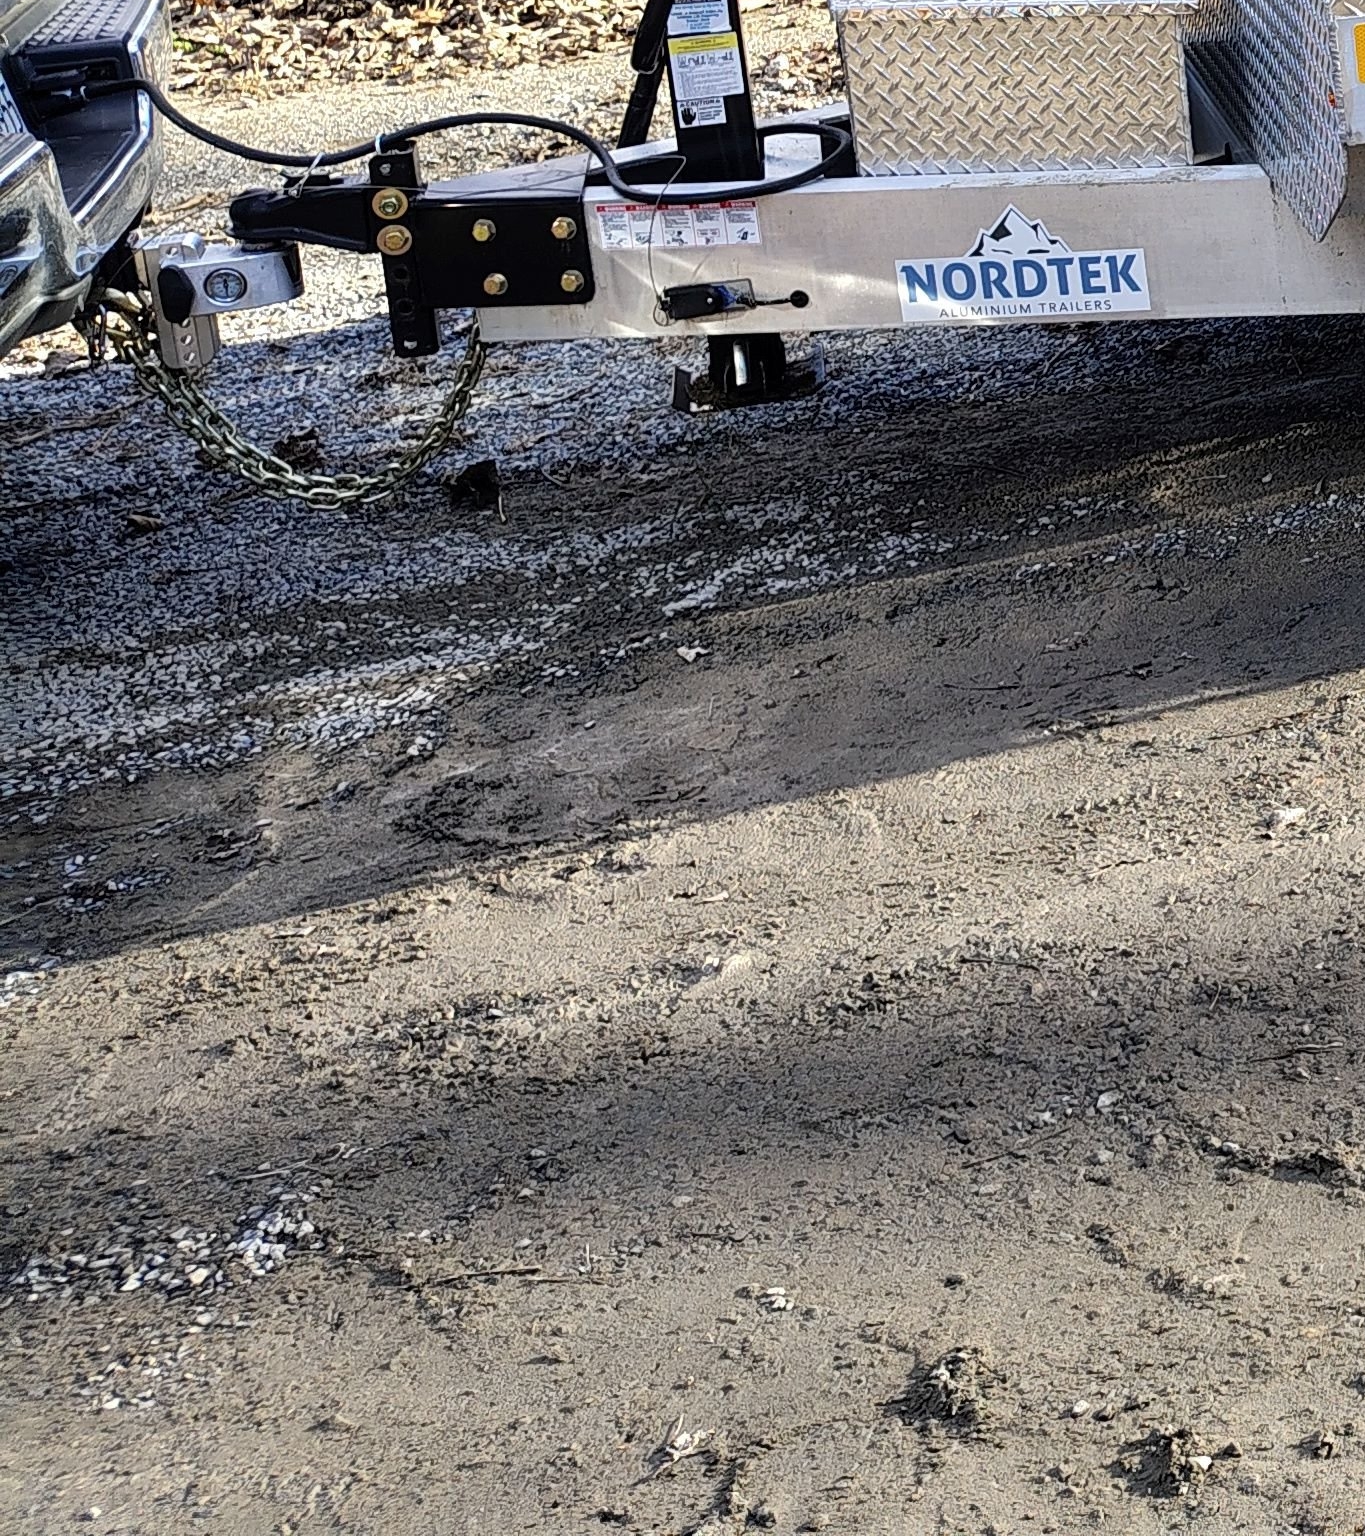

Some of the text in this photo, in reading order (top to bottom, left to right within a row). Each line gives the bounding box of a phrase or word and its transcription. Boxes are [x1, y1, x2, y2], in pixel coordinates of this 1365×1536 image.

[900, 253, 1142, 303] NORDTEK
[939, 299, 1112, 318] ALUMINIUM TRAILERS
